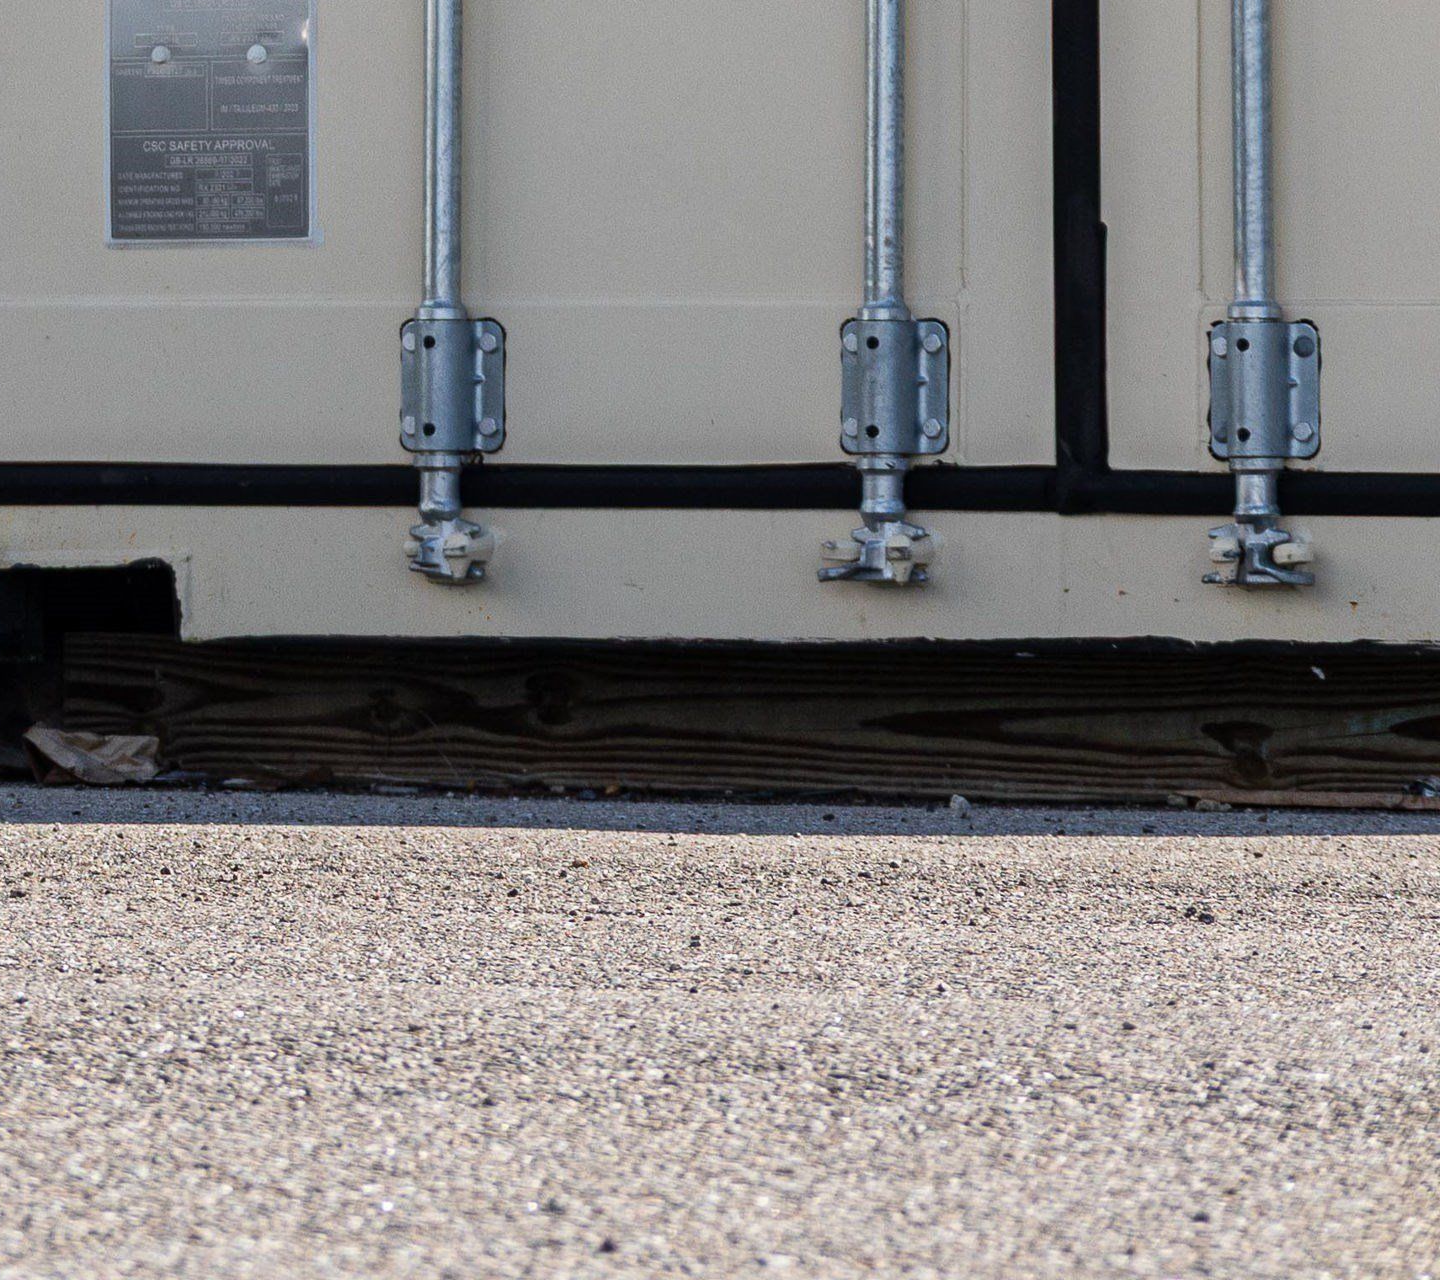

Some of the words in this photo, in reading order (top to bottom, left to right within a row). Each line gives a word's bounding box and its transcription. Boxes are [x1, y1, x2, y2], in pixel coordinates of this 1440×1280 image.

[142, 140, 167, 152] CSC
[168, 140, 212, 152] SAFETY
[214, 139, 276, 151] APPROVAL
